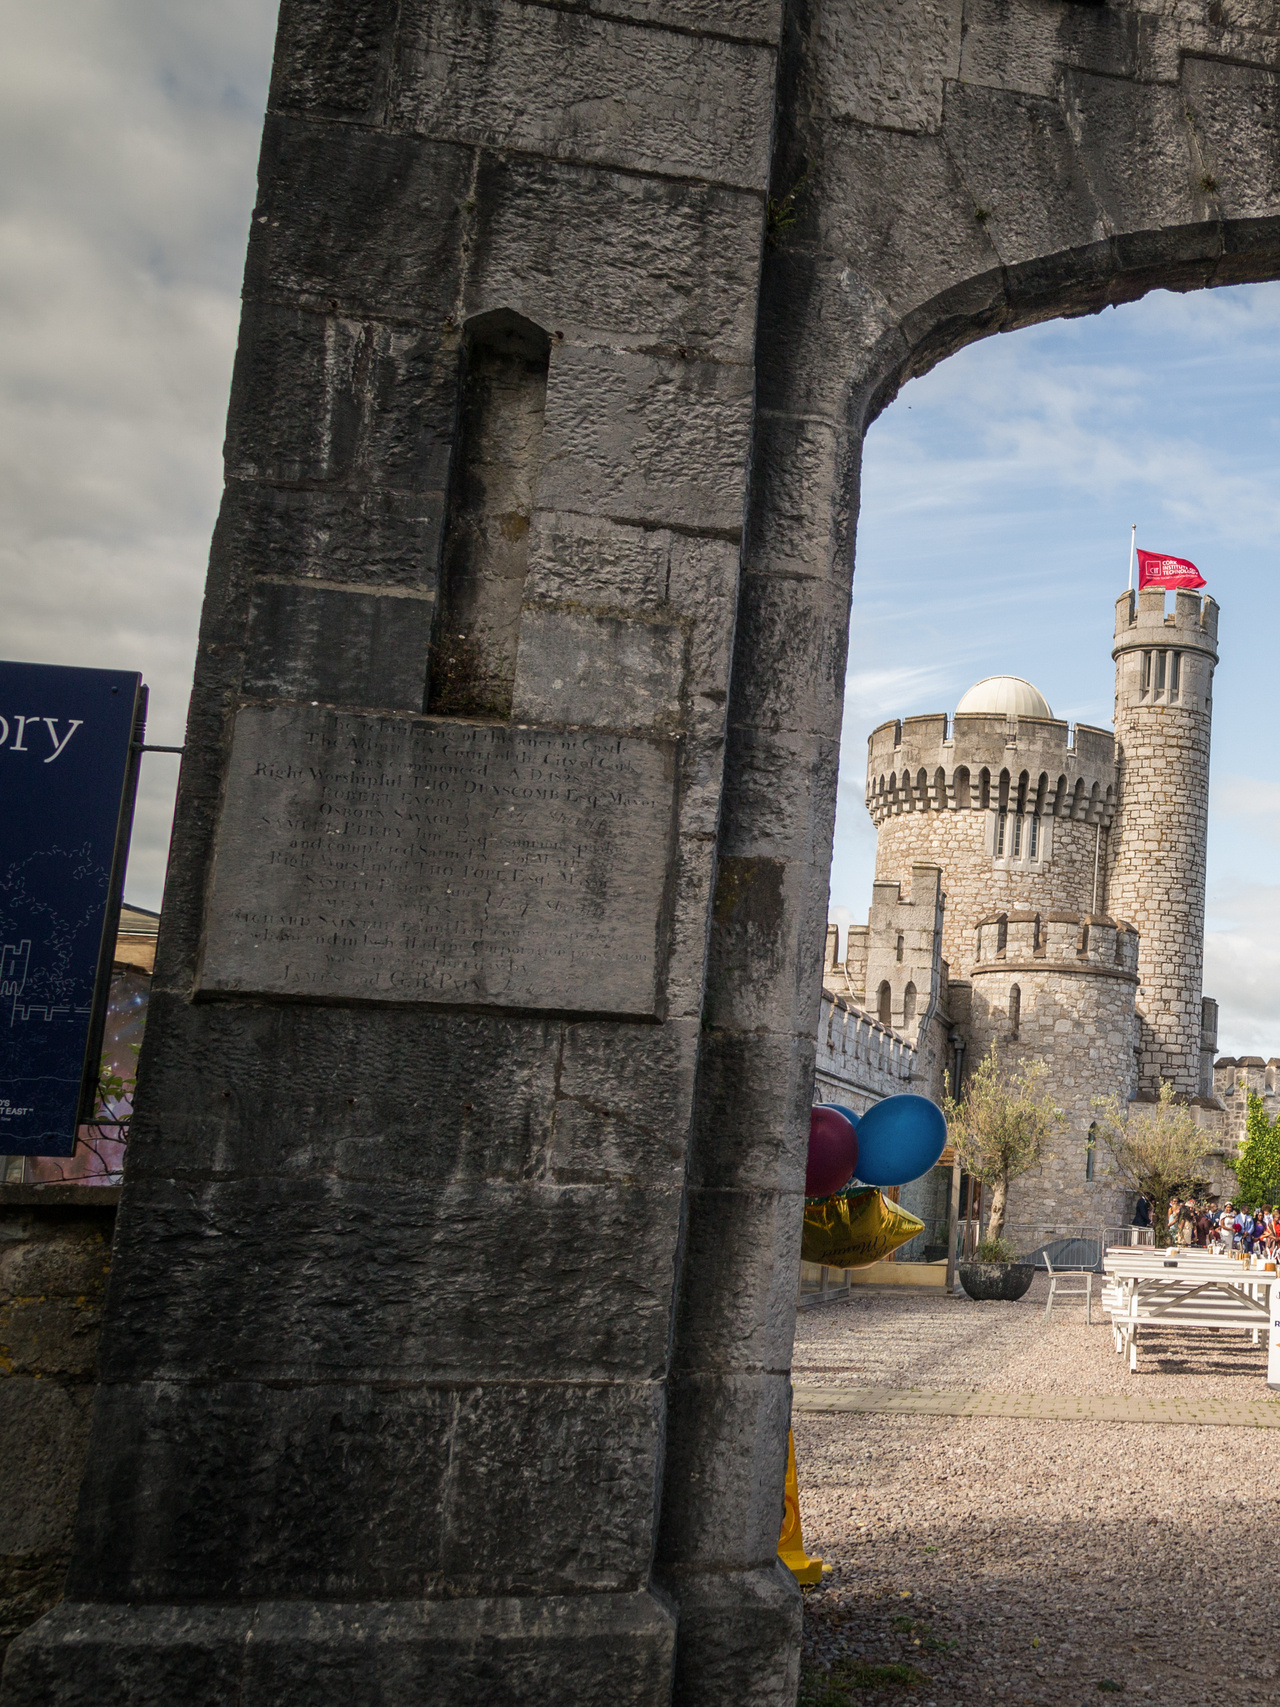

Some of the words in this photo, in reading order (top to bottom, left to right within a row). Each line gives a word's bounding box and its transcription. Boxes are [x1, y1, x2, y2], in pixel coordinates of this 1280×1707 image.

[305, 732, 338, 747] The
[543, 753, 577, 768] City
[255, 762, 302, 781] Right
[310, 767, 403, 789] Worshipful
[289, 837, 322, 851] and
